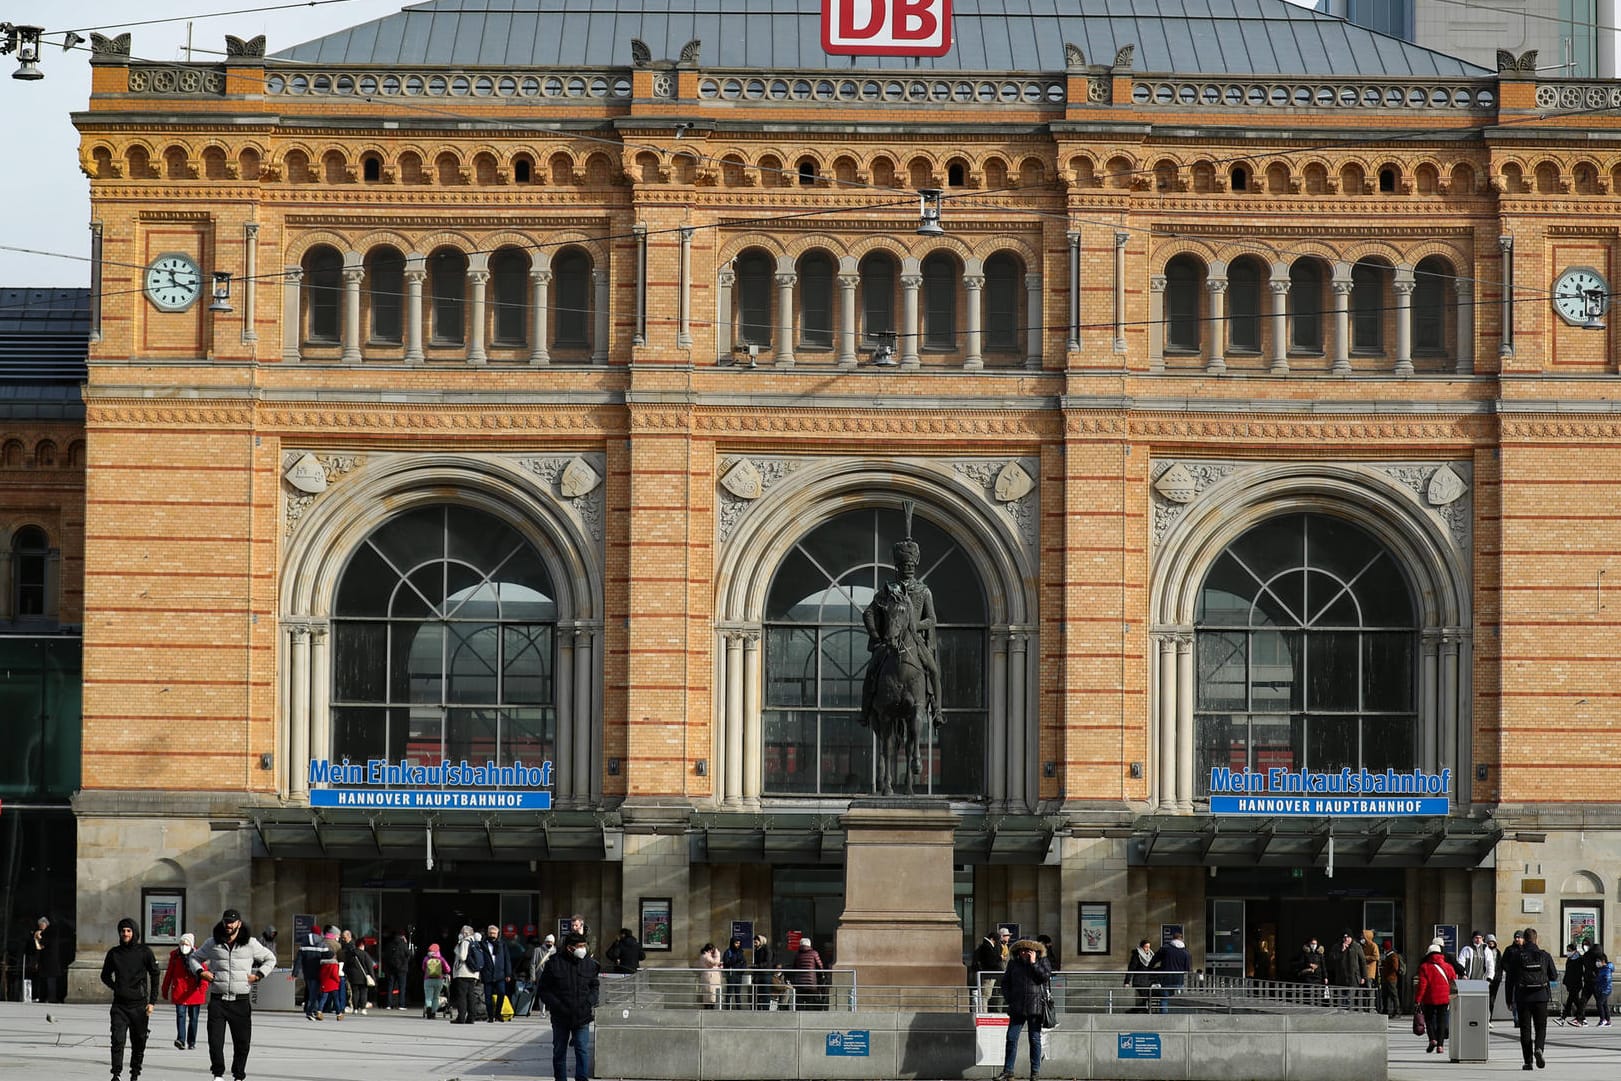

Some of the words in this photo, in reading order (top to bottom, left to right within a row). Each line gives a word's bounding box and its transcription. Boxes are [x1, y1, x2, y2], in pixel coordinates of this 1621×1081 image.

[839, 0, 938, 40] DB
[309, 759, 362, 785] Mein
[367, 759, 551, 786] Einkaufsbahnhof
[1210, 767, 1263, 793] Mein
[1268, 767, 1450, 793] Einkaufsbahnhof
[338, 792, 411, 805] HANNOVER
[415, 792, 524, 806] HAUPTBAHNHOF
[1238, 799, 1310, 812] HANNOVER
[1315, 800, 1422, 813] HAUPTBAHNHOF
